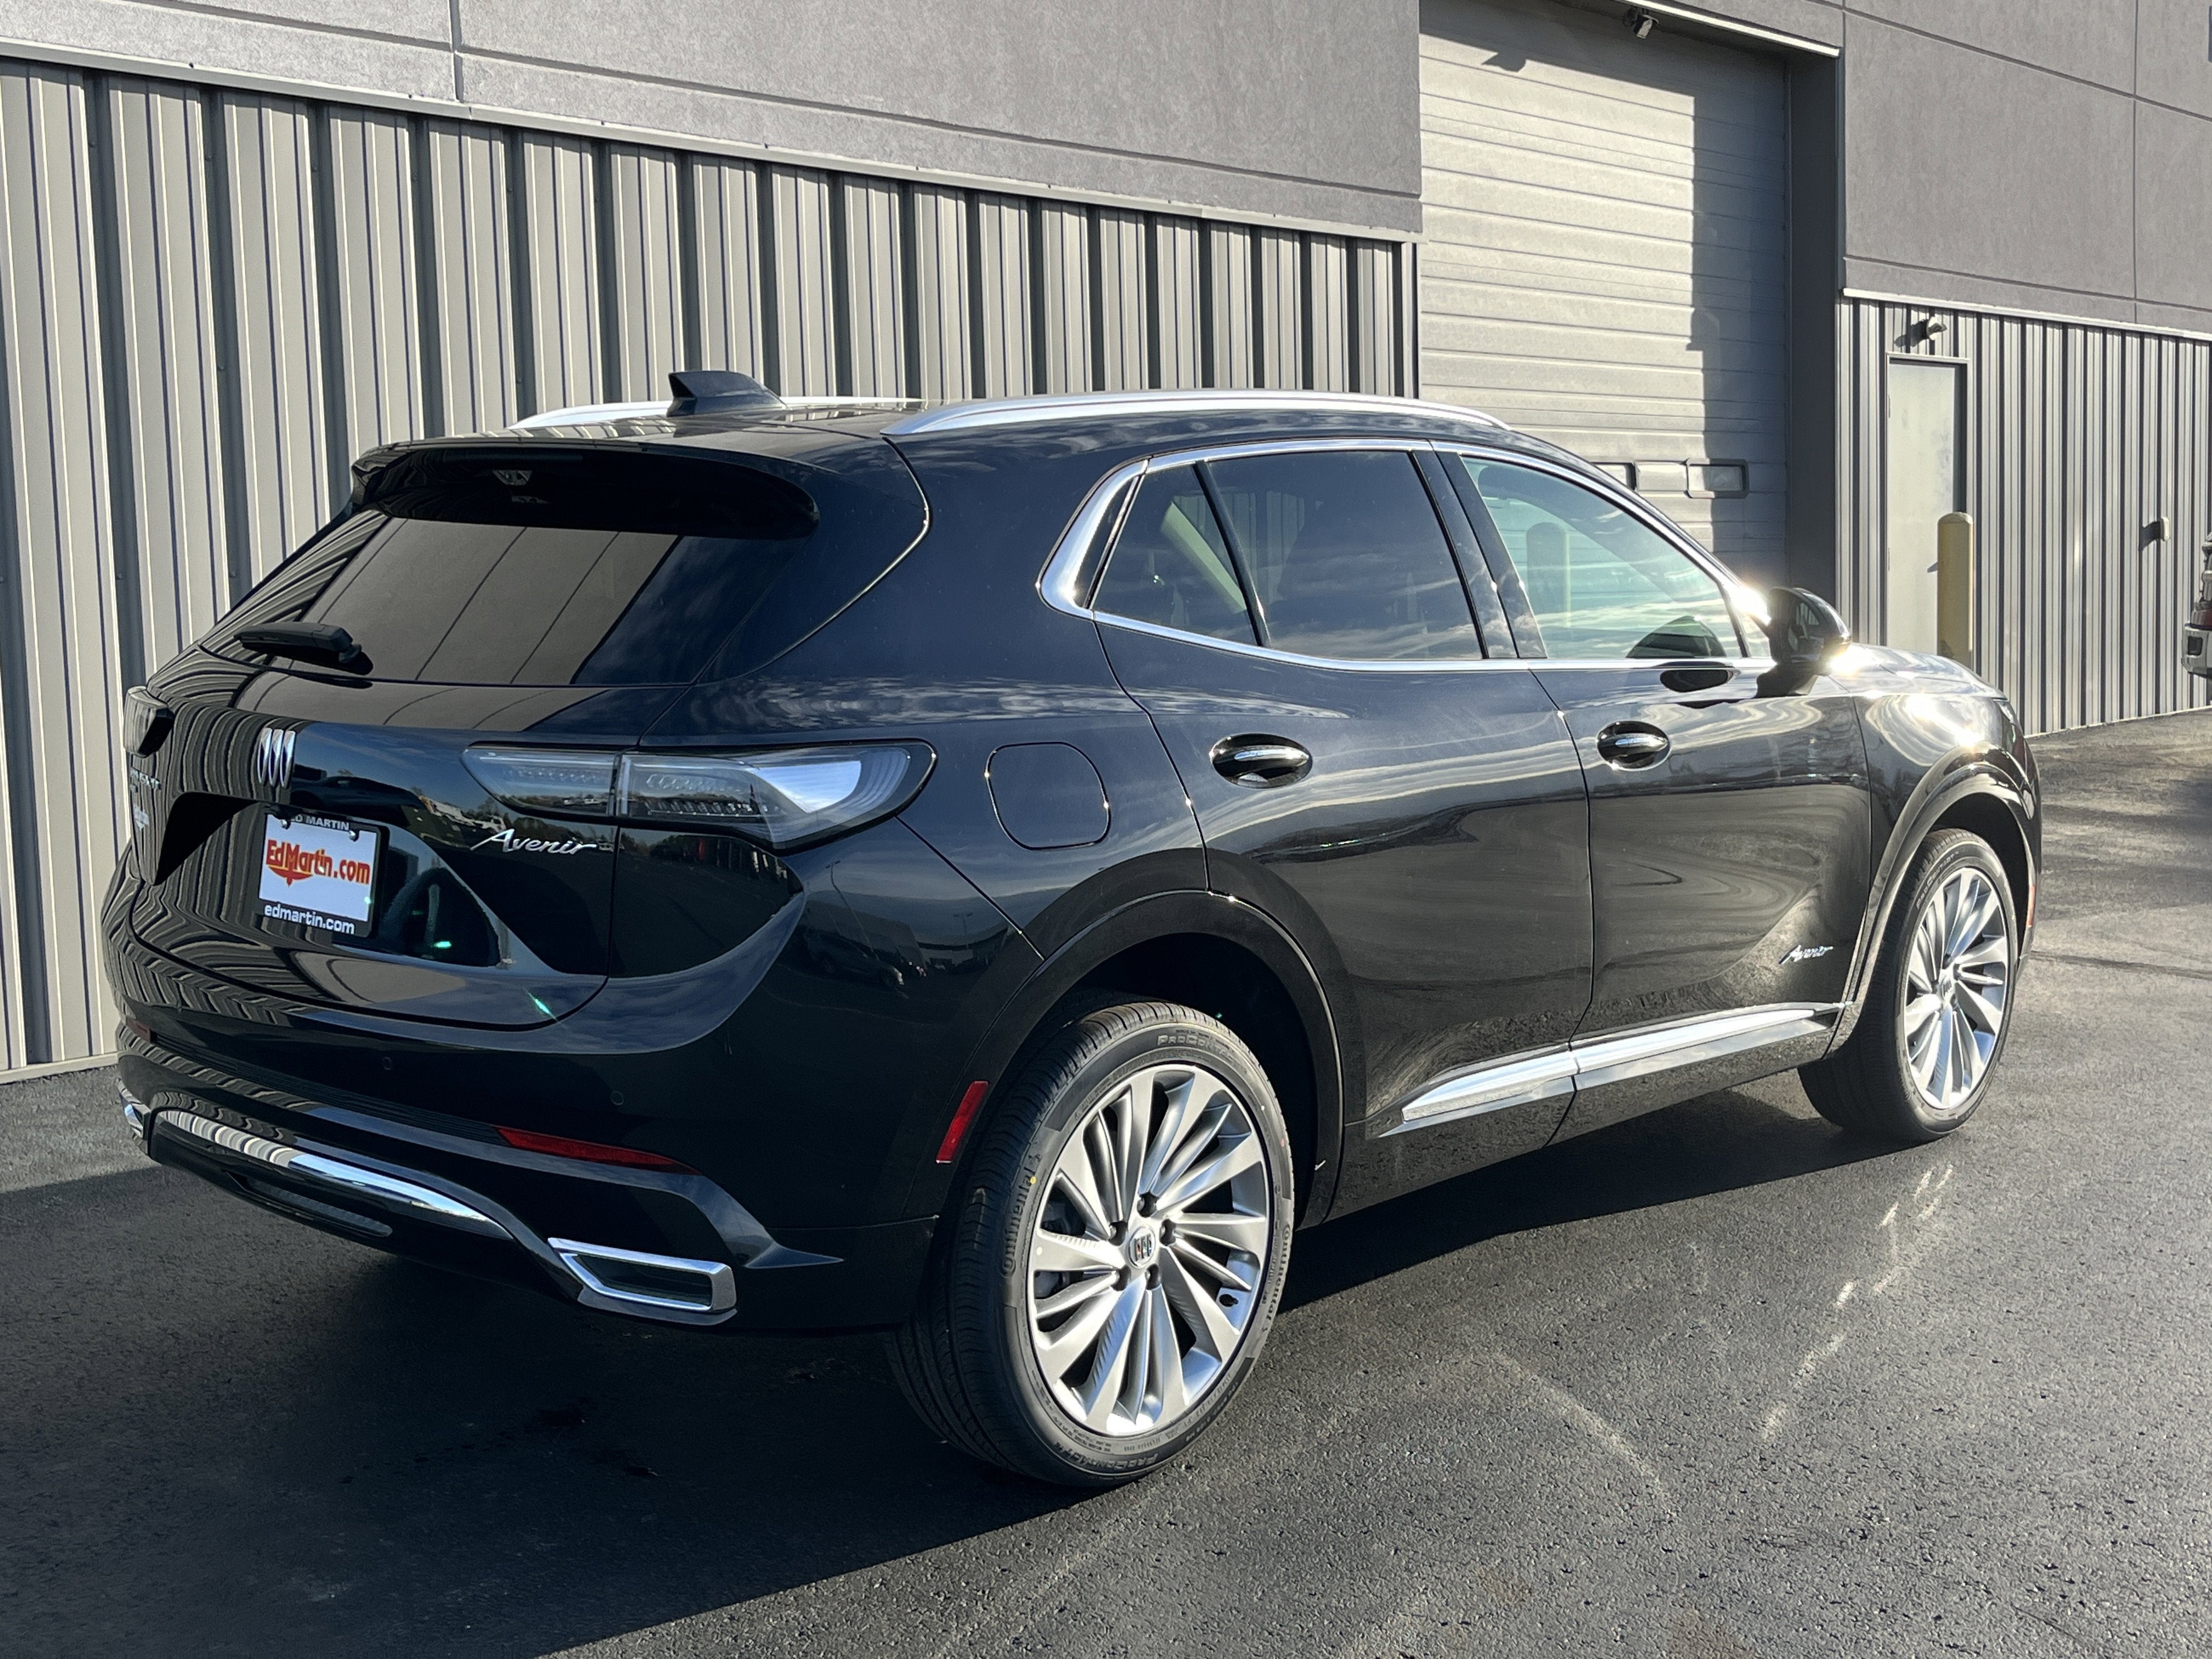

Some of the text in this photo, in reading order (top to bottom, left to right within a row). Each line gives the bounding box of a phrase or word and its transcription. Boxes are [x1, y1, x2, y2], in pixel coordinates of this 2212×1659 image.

[290, 814, 349, 831] D MARTIN
[470, 828, 597, 854] Avenir
[264, 904, 355, 935] edmartin.com
